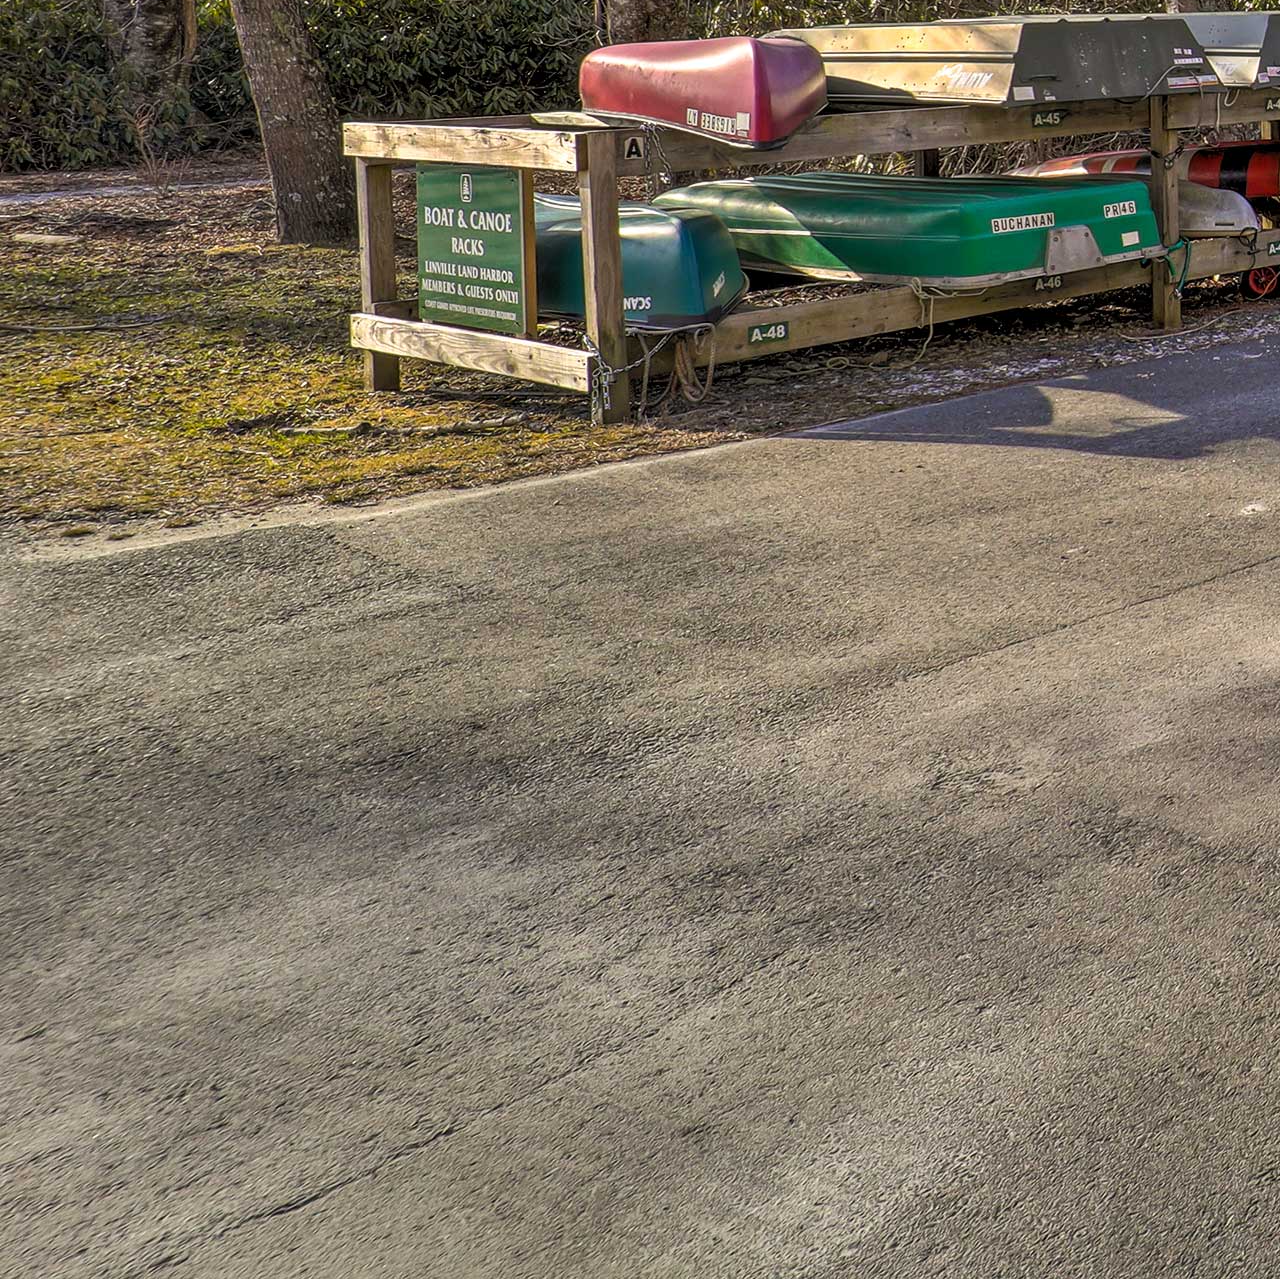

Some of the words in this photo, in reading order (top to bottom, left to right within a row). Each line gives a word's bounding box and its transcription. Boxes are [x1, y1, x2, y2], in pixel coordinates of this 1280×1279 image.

[1033, 112, 1061, 126] A-45
[626, 138, 643, 158] A
[424, 206, 454, 227] BOAT
[457, 210, 468, 228] &
[470, 211, 512, 232] CANOE
[993, 214, 1054, 233] BUCHANAN
[451, 237, 484, 256] RACKS
[425, 260, 456, 276] LINVILLE
[458, 264, 478, 279] LAND
[480, 268, 514, 284] HARBOR
[422, 278, 456, 294] MEMBERS
[457, 283, 464, 296] &
[465, 285, 493, 300] GUESTS
[1035, 275, 1062, 291] A-46
[750, 325, 786, 343] A-48
